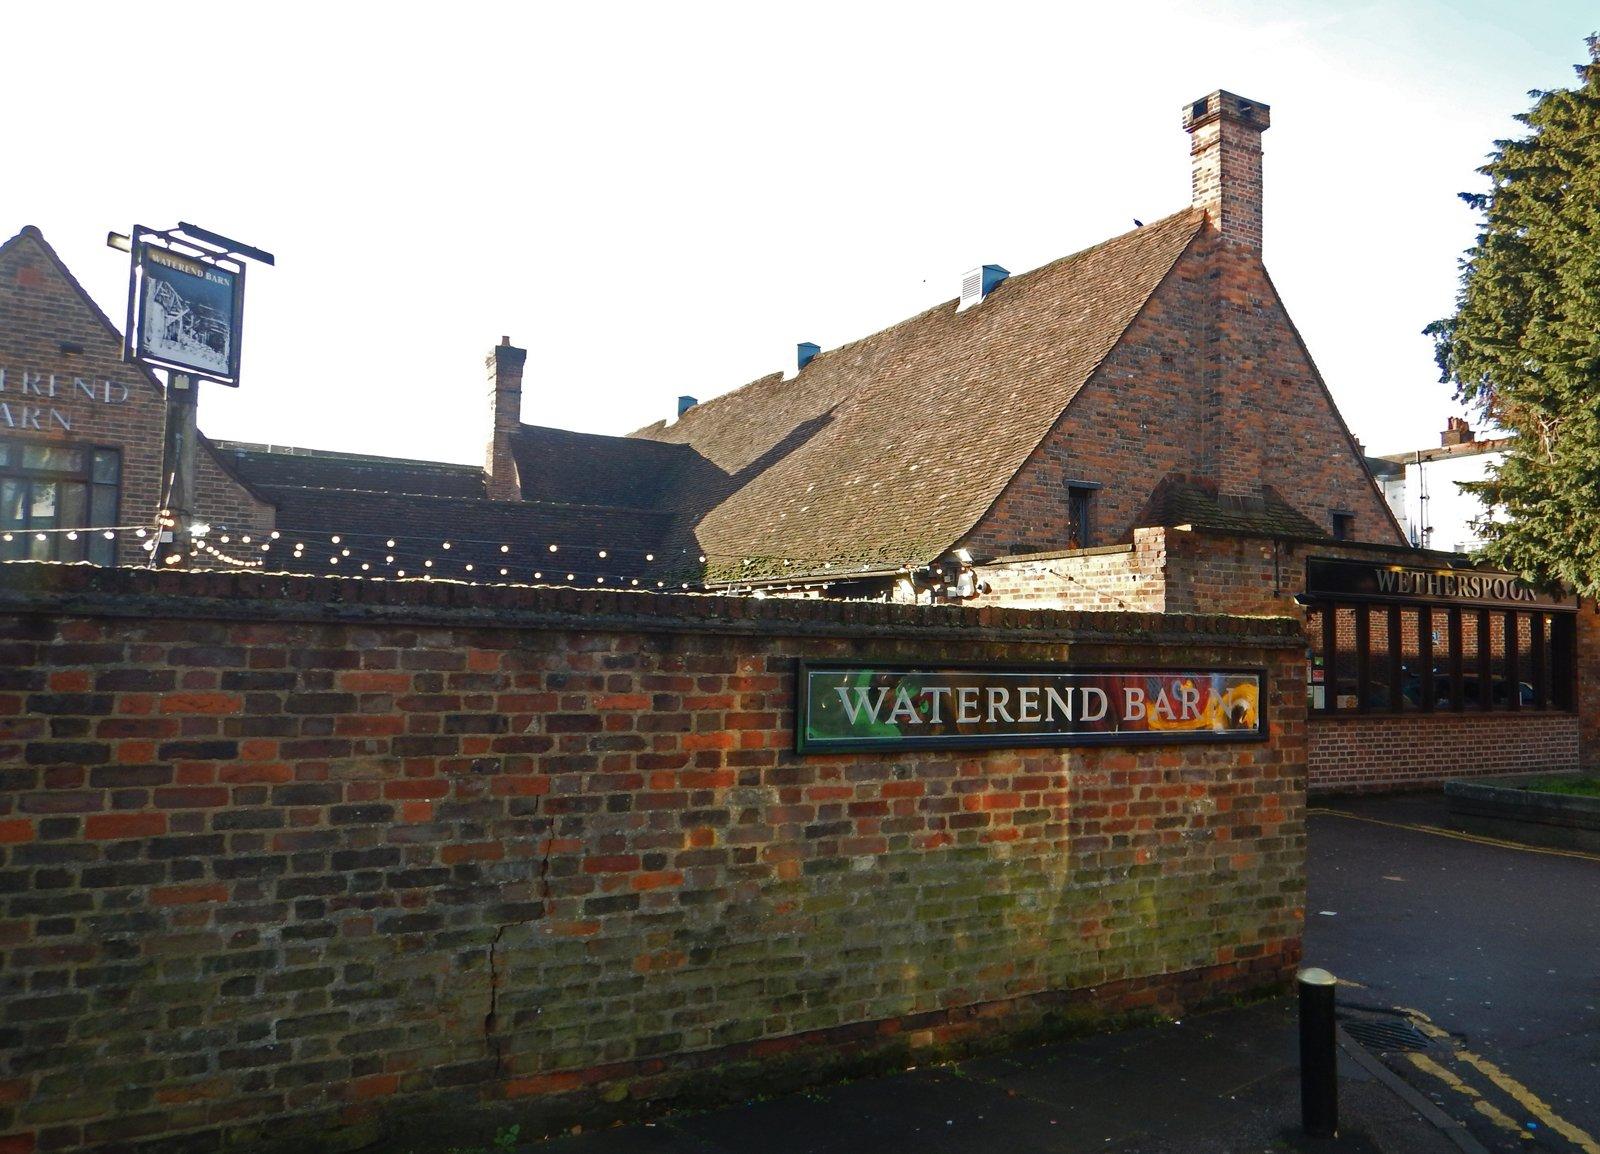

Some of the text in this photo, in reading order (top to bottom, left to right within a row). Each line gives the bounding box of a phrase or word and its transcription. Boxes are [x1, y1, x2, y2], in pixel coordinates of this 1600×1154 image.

[152, 254, 231, 287] WATEREND BARN
[834, 686, 1235, 725] WATEREND BARN
